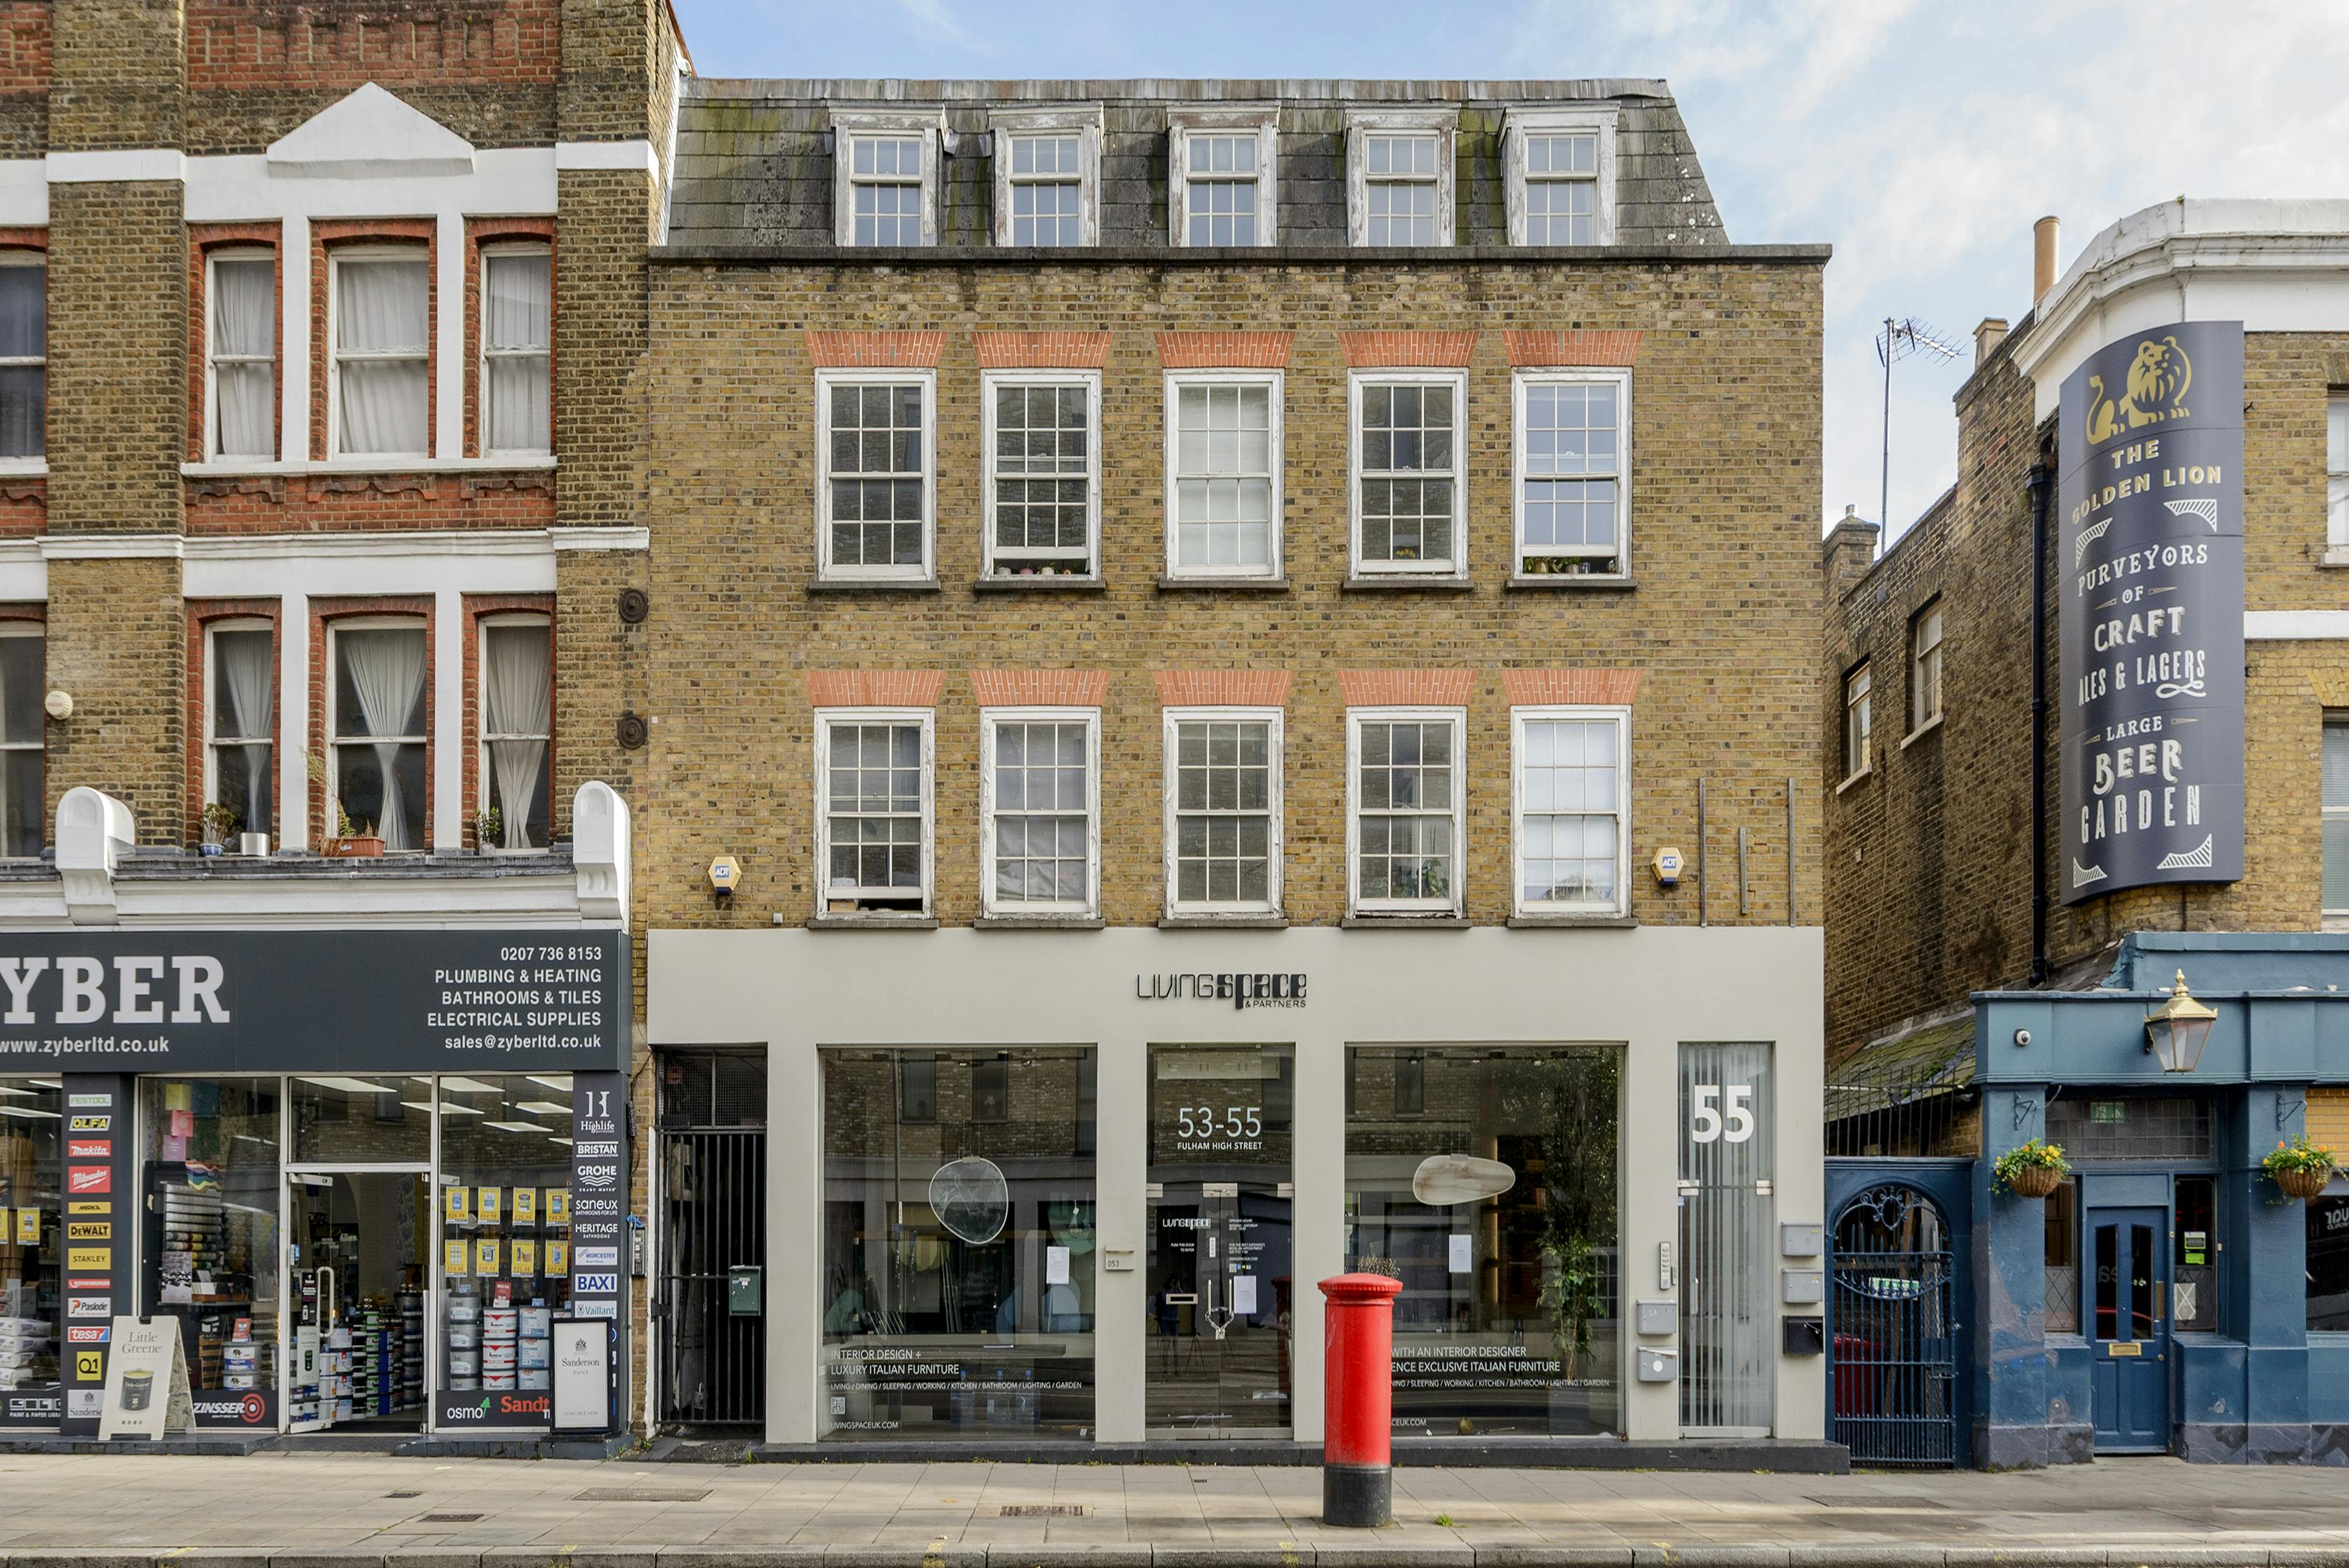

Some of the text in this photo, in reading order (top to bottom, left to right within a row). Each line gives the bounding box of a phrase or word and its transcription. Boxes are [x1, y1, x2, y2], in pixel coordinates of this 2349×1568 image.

[2111, 438, 2159, 469] THE
[2071, 465, 2221, 525] GOLDEN LION
[2077, 543, 2208, 597] PURVEYORS
[2122, 584, 2144, 604] OF
[2094, 605, 2185, 653] CRAFT
[2078, 650, 2207, 707] ALES & LAGERS
[2106, 715, 2163, 742] LARGE
[2093, 738, 2184, 796] BEER
[2081, 785, 2200, 845] GARDEN
[1662, 858, 1677, 867] ADT
[715, 868, 729, 876] ADT
[501, 946, 602, 961] 0207 736 8153
[435, 969, 602, 984] PLUMBING & HEATING
[0, 955, 230, 1024] YBER
[442, 991, 602, 1005] BATHROOMS & TILES
[427, 1011, 602, 1026] ELECTRICAL SUPPLIES
[0, 1036, 170, 1057] www.zyberltd.co.uk
[445, 1034, 602, 1052] sales@zyberltd.co.uk
[1692, 1084, 1754, 1143] 55
[72, 1118, 107, 1130] OLFA
[581, 1120, 615, 1134] Highlife
[1178, 1107, 1261, 1137] 53-55
[577, 1145, 617, 1154] BRISTAN
[1177, 1142, 1210, 1150] FULHAM
[577, 1165, 617, 1176] GROHE
[576, 1200, 618, 1210] saneux
[575, 1223, 618, 1233] HERITAGE
[577, 1276, 615, 1290] BAXI
[81, 1303, 107, 1311] Paslode
[585, 1305, 615, 1315] Vaillant
[72, 1328, 97, 1340] tesa
[129, 1331, 157, 1343] Little
[122, 1343, 162, 1354] Greene
[831, 1349, 875, 1359] INTERIOR
[877, 1349, 913, 1359] DESIGN
[1391, 1347, 1526, 1357] WITH AN INTERIOR DESIGNER
[79, 1358, 98, 1374] Q1
[561, 1358, 599, 1367] Sanderson
[831, 1364, 959, 1375] LUXURY ITALIAN FURNITURE
[1418, 1361, 1468, 1372] EXCLUSIVE
[1471, 1361, 1506, 1372] ITALIAN
[1509, 1361, 1561, 1371] FURNITURE
[193, 1402, 245, 1414] ZINSSER
[447, 1407, 483, 1419] osmo
